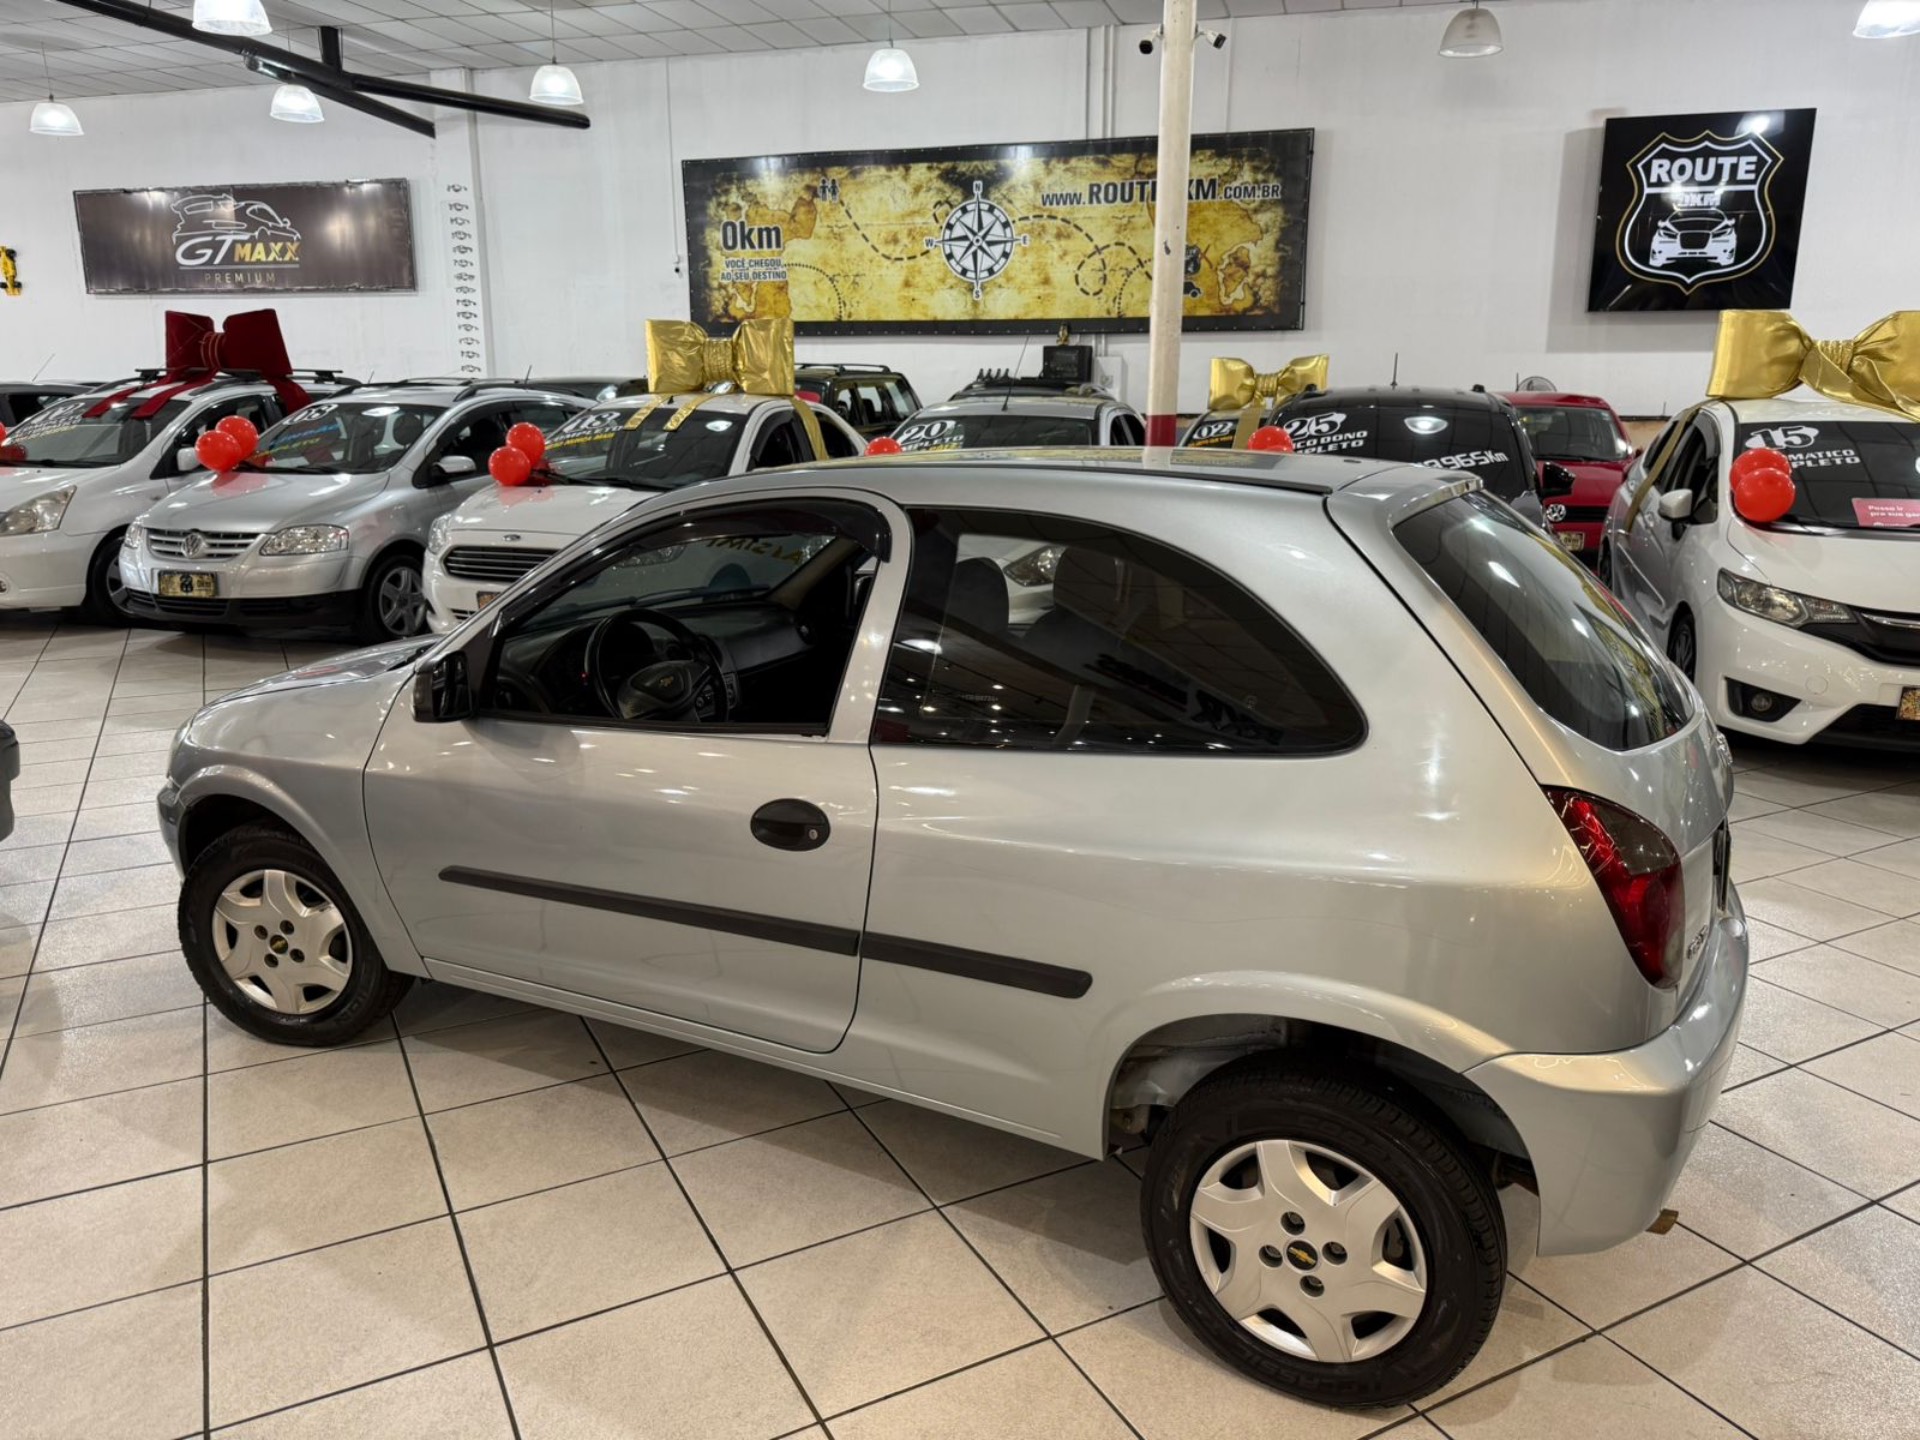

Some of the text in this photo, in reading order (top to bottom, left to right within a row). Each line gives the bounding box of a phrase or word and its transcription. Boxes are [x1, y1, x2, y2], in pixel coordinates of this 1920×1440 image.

[1649, 155, 1758, 183] ROUTE
[204, 272, 276, 283] PREMIUM
[720, 270, 787, 281] AO SEU DESTINO
[1284, 412, 1343, 440] 25
[1320, 431, 1368, 445] DONO
[1748, 426, 1816, 449] 15
[1297, 440, 1364, 454] PLETO
[1788, 449, 1855, 461] MATICO
[1791, 456, 1861, 469] PLETO
